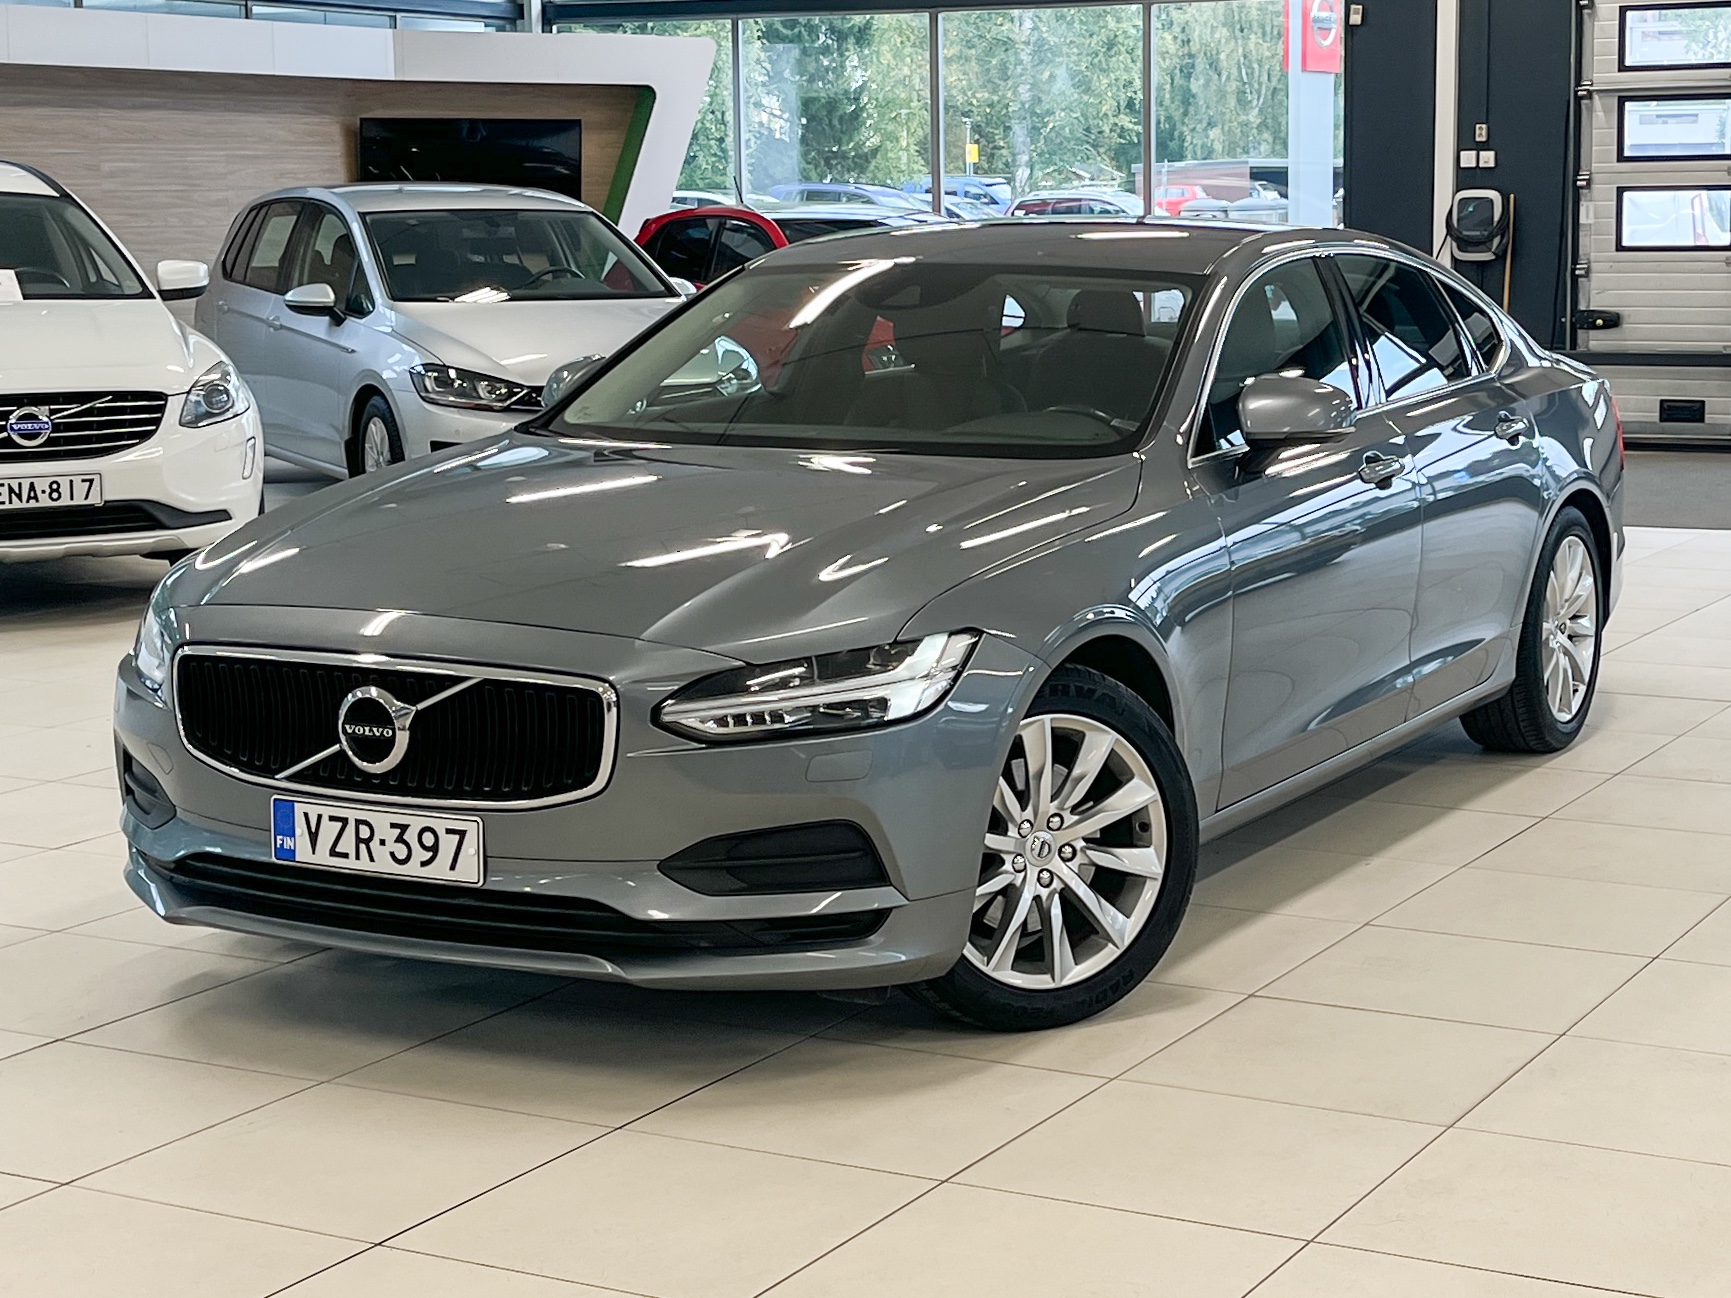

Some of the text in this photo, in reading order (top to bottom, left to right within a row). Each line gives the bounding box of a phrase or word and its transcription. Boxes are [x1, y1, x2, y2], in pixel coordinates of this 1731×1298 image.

[344, 724, 393, 737] VOLVO
[276, 812, 468, 871] FIN VZR-397
